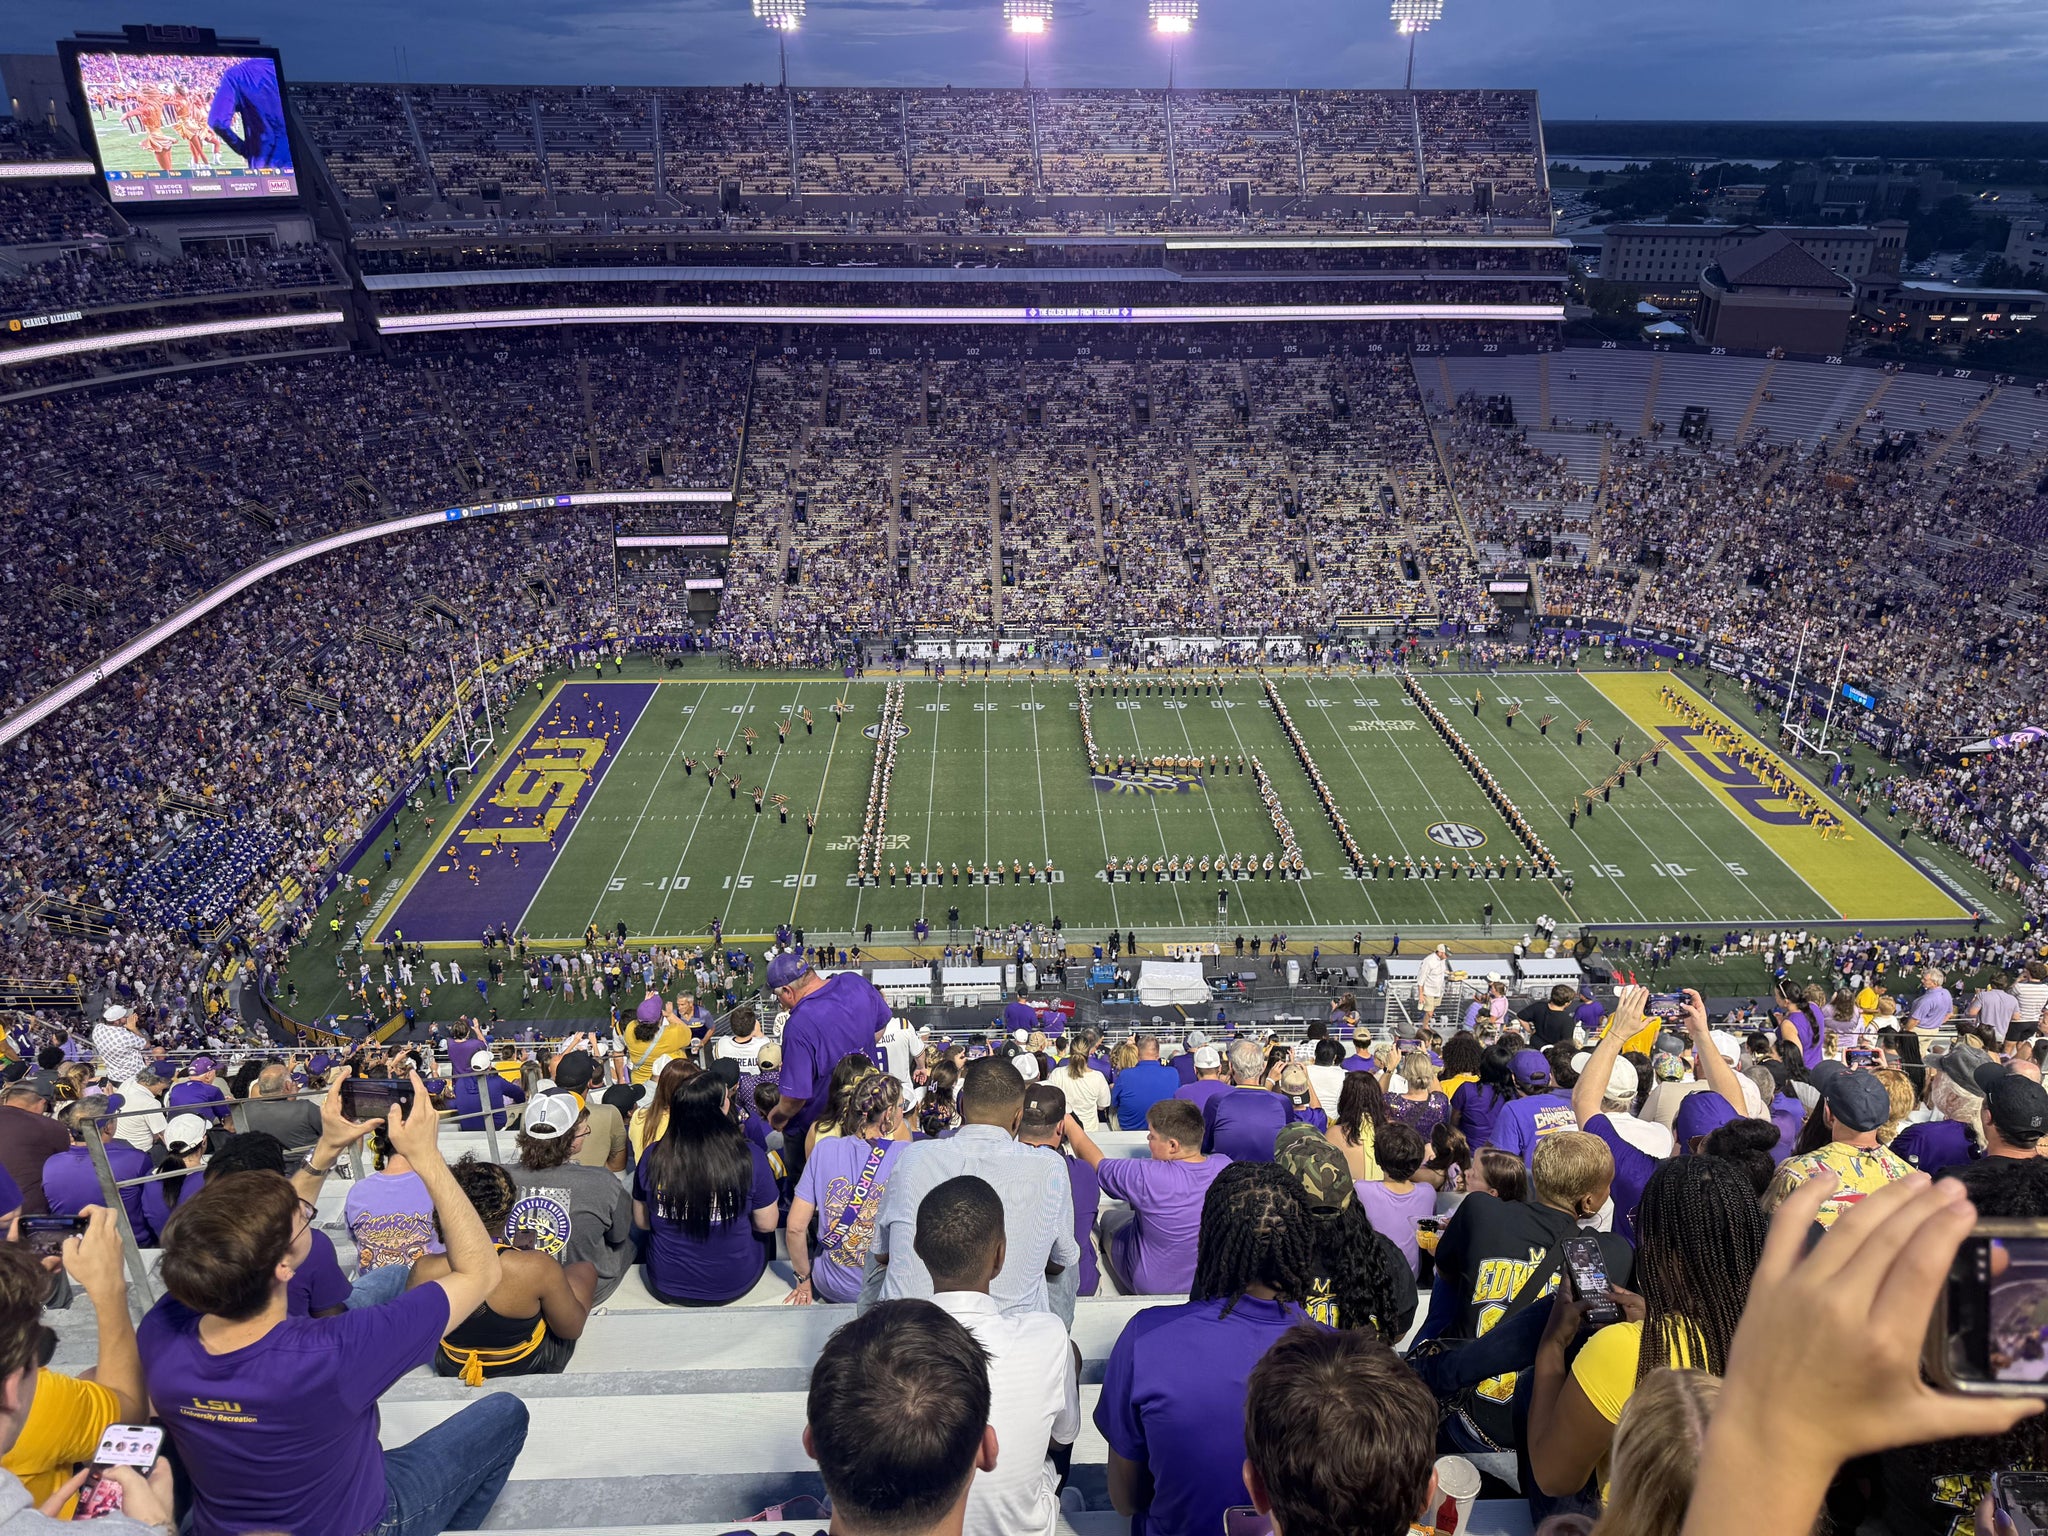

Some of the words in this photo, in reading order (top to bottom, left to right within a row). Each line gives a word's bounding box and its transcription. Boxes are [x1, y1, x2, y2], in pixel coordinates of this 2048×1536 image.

[146, 24, 200, 42] LSU
[22, 316, 48, 328] CHARLES
[50, 311, 82, 324] ALEXANDER
[1711, 347, 1726, 355] 225
[1825, 356, 1842, 364] 226
[1954, 369, 1971, 378] 227
[92, 668, 102, 682] 25
[926, 703, 950, 711] 30
[974, 703, 998, 711] 35
[1022, 703, 1045, 711] 40
[1116, 702, 1141, 710] 50
[1163, 701, 1188, 709] 45
[1211, 701, 1235, 709] 40
[1545, 696, 1560, 705] 5
[681, 705, 695, 714] 5
[731, 704, 755, 713] 10
[779, 704, 804, 713] 15
[1655, 725, 1844, 826] LSU
[463, 738, 606, 844] LSU
[842, 834, 911, 843] GLAL
[1429, 823, 1483, 848] SEC
[825, 842, 910, 851] VEURE
[1589, 864, 1626, 878] 15
[1650, 863, 1688, 877] 10
[1725, 862, 1749, 876] 5
[658, 876, 691, 890] 10
[722, 875, 754, 889] 15
[783, 874, 817, 888] 20
[1034, 870, 1065, 883] 40
[608, 877, 627, 891] 5
[366, 892, 394, 918] CANE'S
[848, 1146, 885, 1214] SATURDAY
[509, 1204, 526, 1233] OUISIANA
[526, 1200, 548, 1208] STATE
[549, 1204, 567, 1240] UNIVERSITY
[192, 1398, 242, 1412] LSU
[180, 1408, 216, 1421] University
[218, 1414, 257, 1422] Recreation
